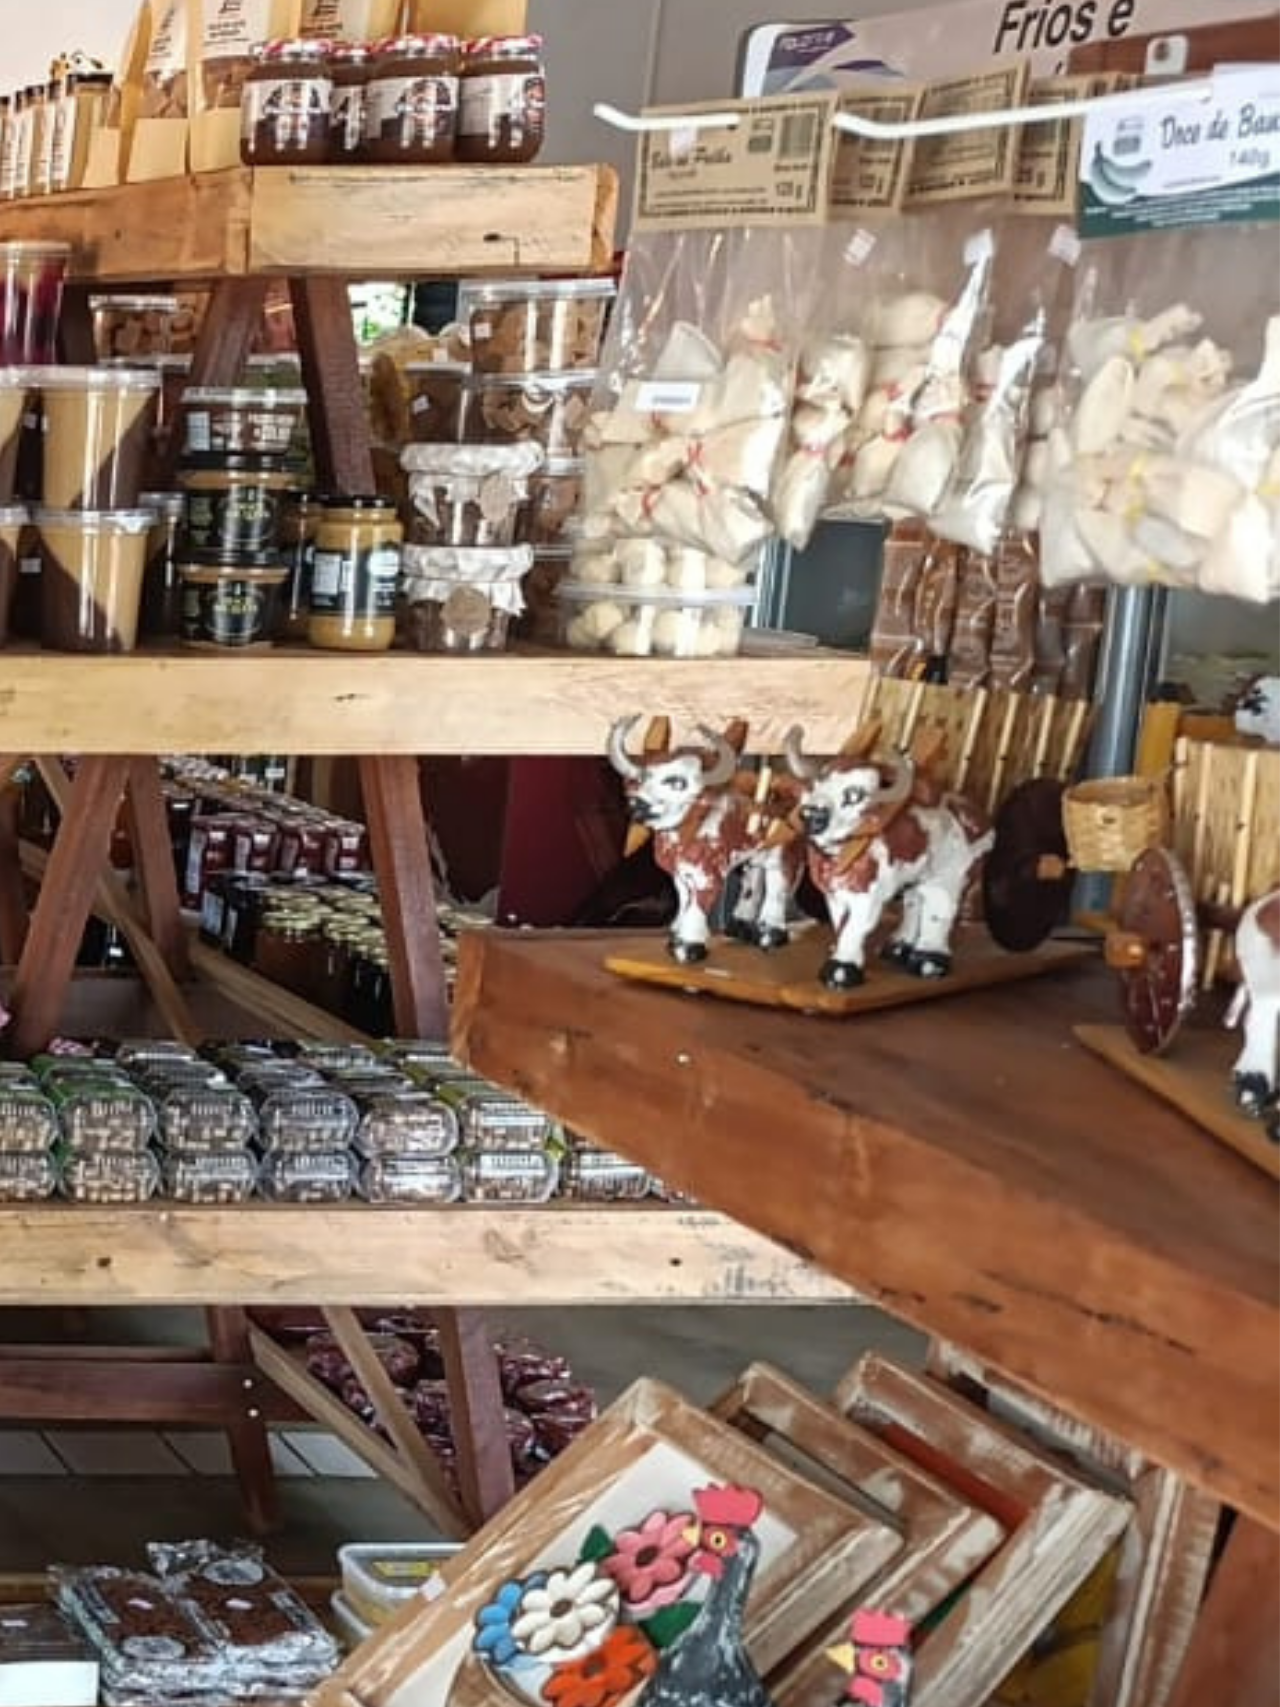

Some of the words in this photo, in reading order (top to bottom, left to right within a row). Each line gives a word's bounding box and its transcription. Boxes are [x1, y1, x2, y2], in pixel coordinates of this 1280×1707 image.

[992, 0, 1097, 54] Frios
[1108, 0, 1135, 36] e
[1162, 115, 1201, 149] Doce
[1207, 109, 1229, 140] de
